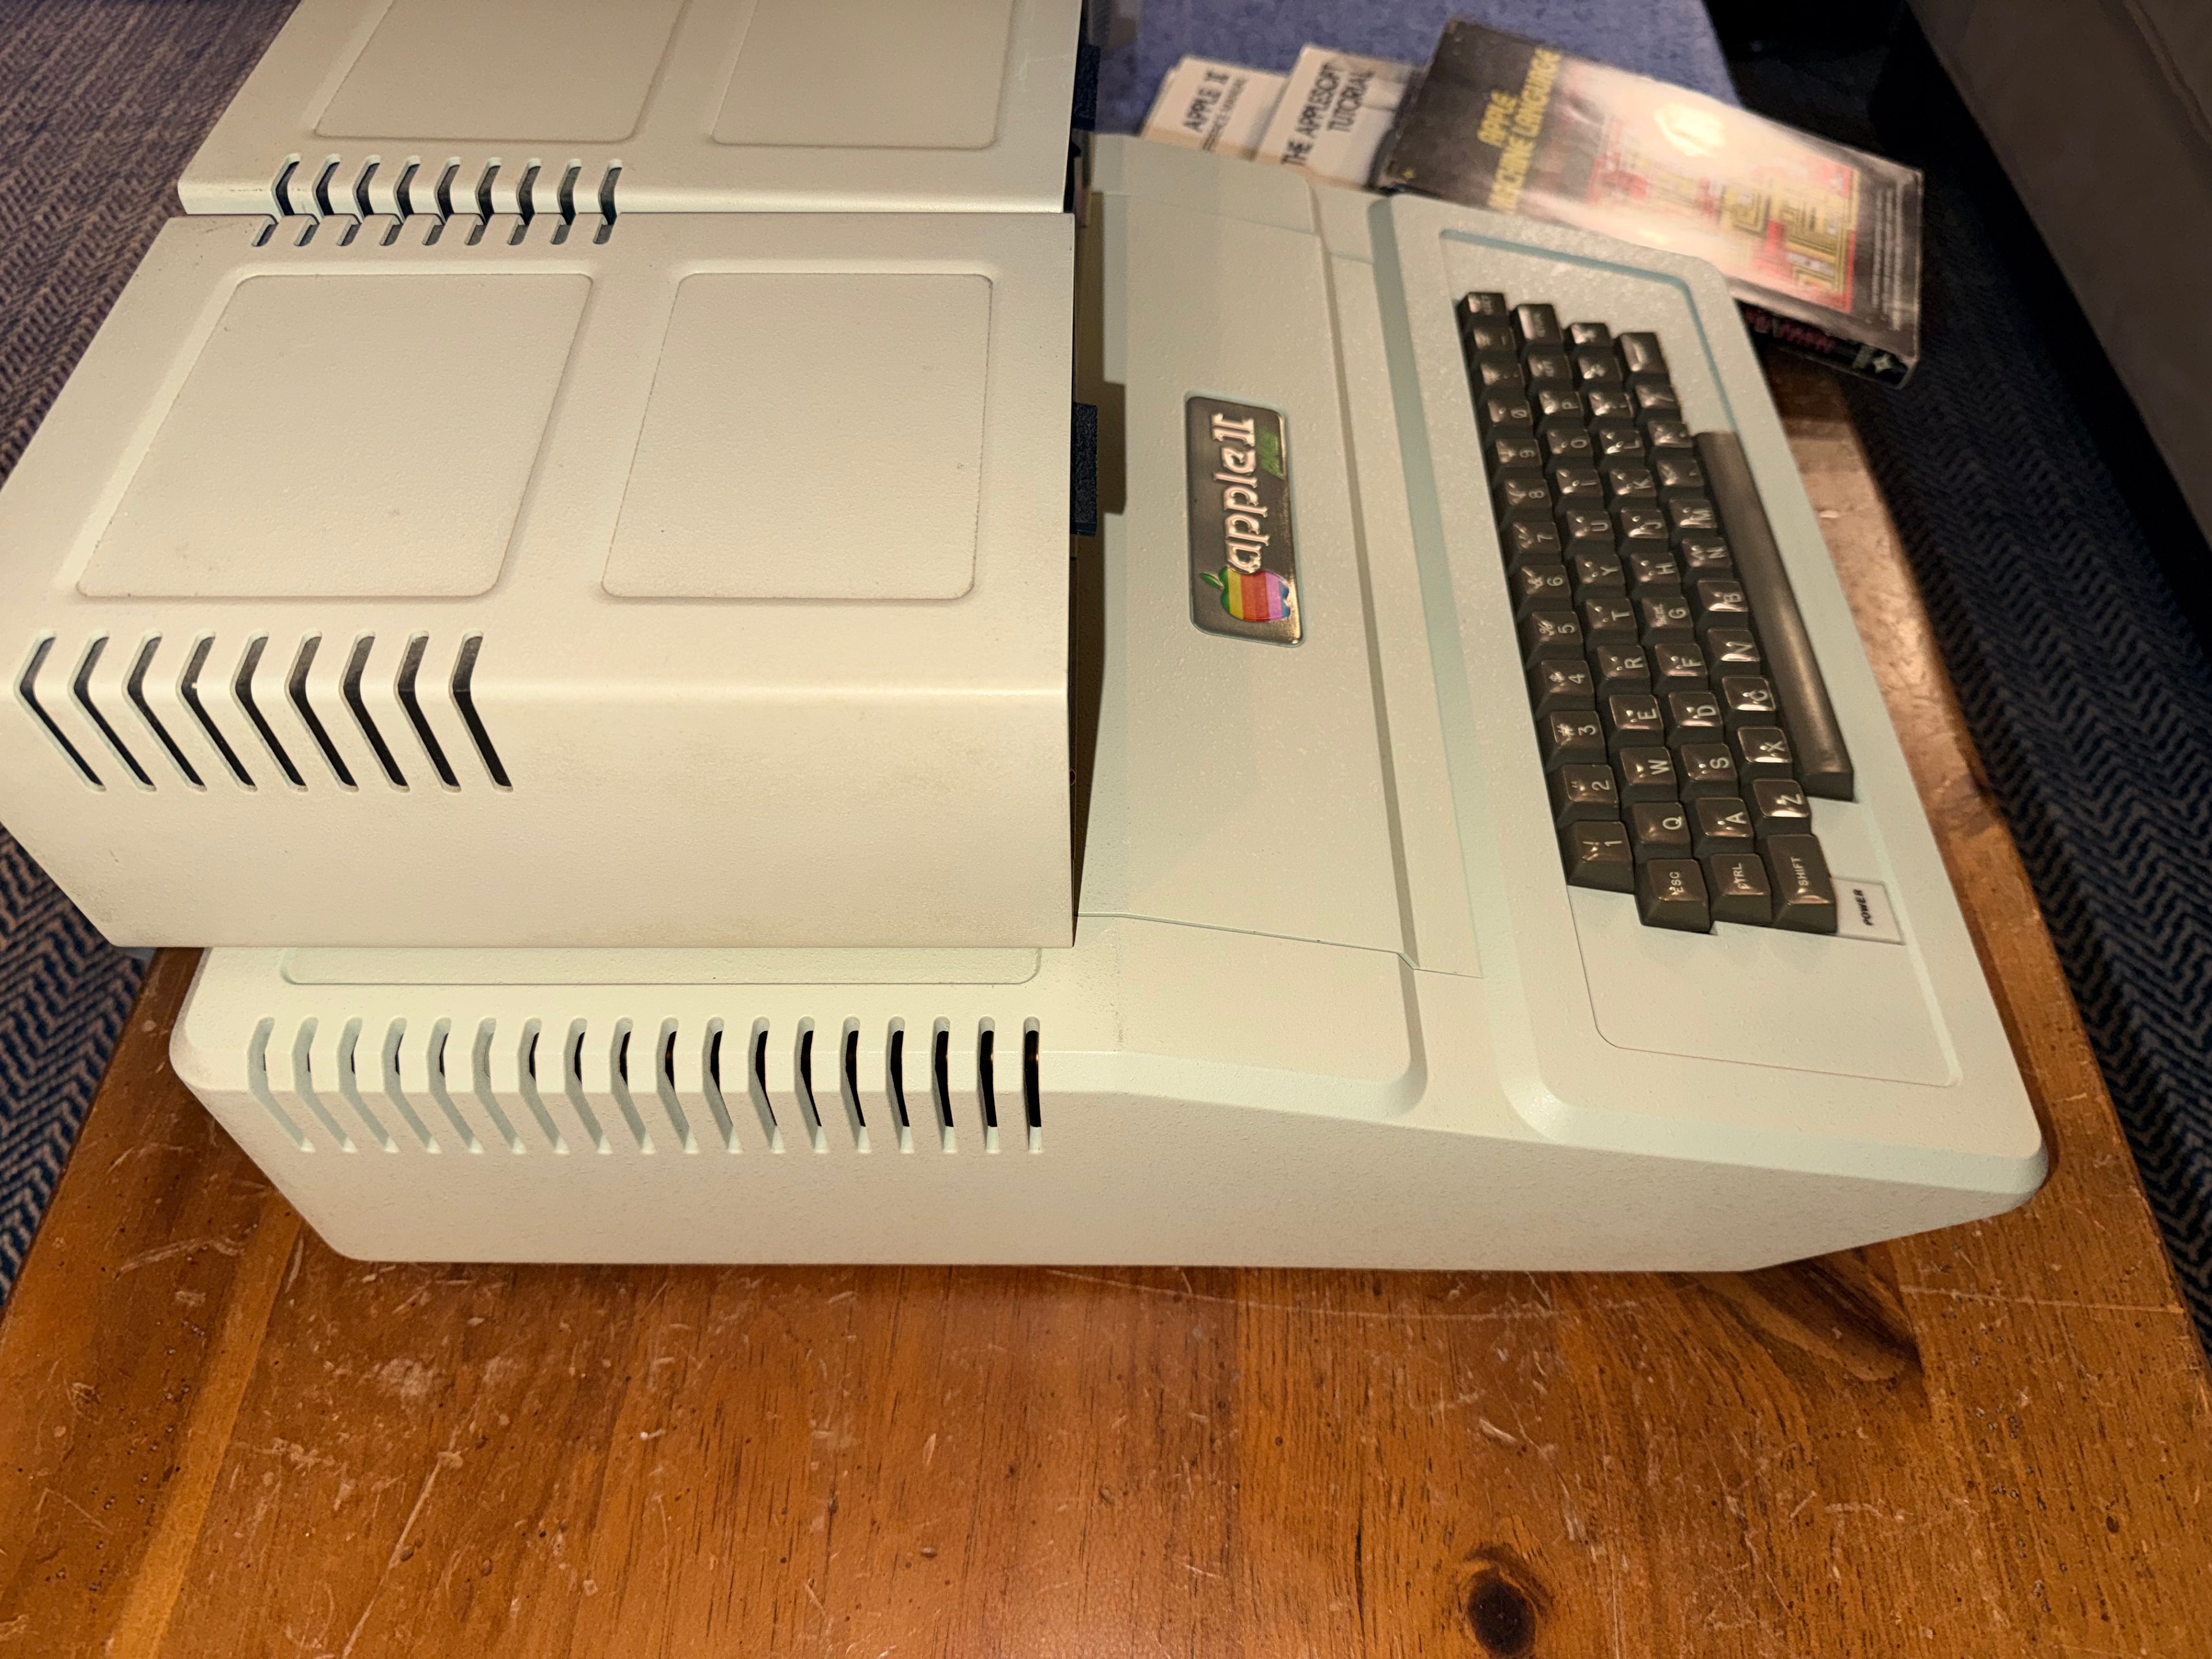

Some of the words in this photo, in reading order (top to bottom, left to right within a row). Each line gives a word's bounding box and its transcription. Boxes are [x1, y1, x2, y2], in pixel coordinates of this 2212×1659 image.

[1295, 60, 1344, 138] APPLESOFT
[1326, 70, 1375, 132] TUTORIAL
[1183, 88, 1222, 133] APPLE
[1280, 141, 1314, 164] THE
[1519, 449, 1536, 457] 9
[1528, 490, 1545, 498] 8
[1212, 445, 1270, 574] apple
[1590, 520, 1609, 531] U
[1536, 532, 1554, 542] 7
[1600, 565, 1620, 575] Y
[1655, 561, 1677, 574] H
[1546, 576, 1564, 586] 6
[1611, 609, 1631, 620] T
[1668, 607, 1687, 618] G
[1558, 623, 1575, 633] 5
[1624, 656, 1645, 668] R
[1681, 656, 1703, 667] F
[1568, 673, 1585, 683] 4
[1637, 708, 1658, 719] E
[1696, 704, 1717, 717] D
[1577, 724, 1596, 735] 3
[1647, 759, 1670, 774] W
[1709, 756, 1730, 768] S
[1592, 779, 1610, 790] 2
[1662, 816, 1682, 829] Q
[1725, 812, 1747, 823] A
[1732, 862, 1748, 888] CTRL
[1790, 856, 1809, 886] SHIFT
[1669, 871, 1684, 893] ESC
[1853, 888, 1874, 925] POWER
